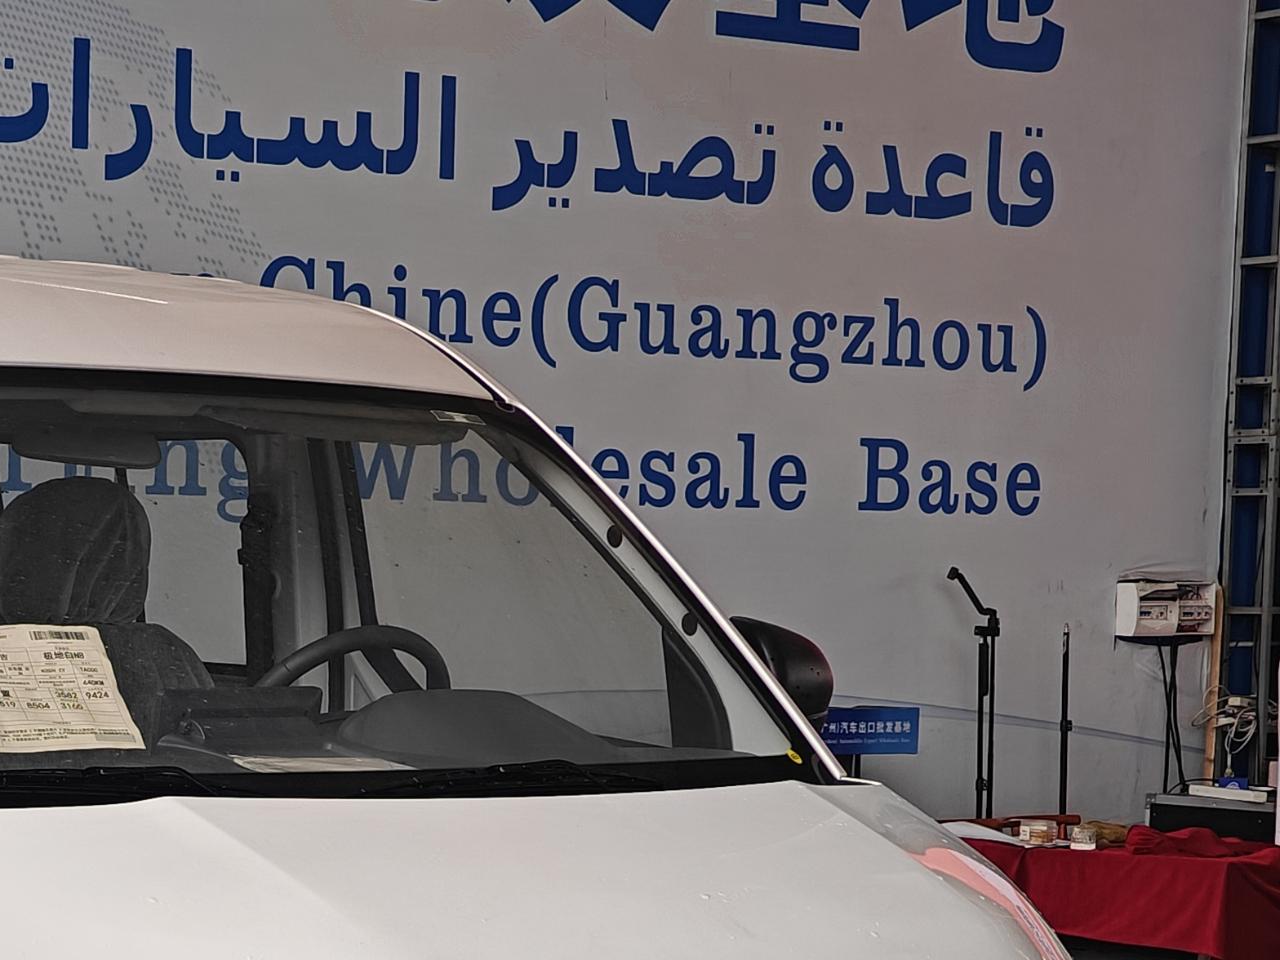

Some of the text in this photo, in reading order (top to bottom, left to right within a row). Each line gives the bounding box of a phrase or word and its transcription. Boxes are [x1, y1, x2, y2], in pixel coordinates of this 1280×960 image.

[491, 118, 777, 212] تصدير
[811, 119, 1055, 229] قاعدة
[352, 425, 808, 511] Whoesale
[857, 436, 1043, 516] Base
[85, 691, 109, 699] 9424
